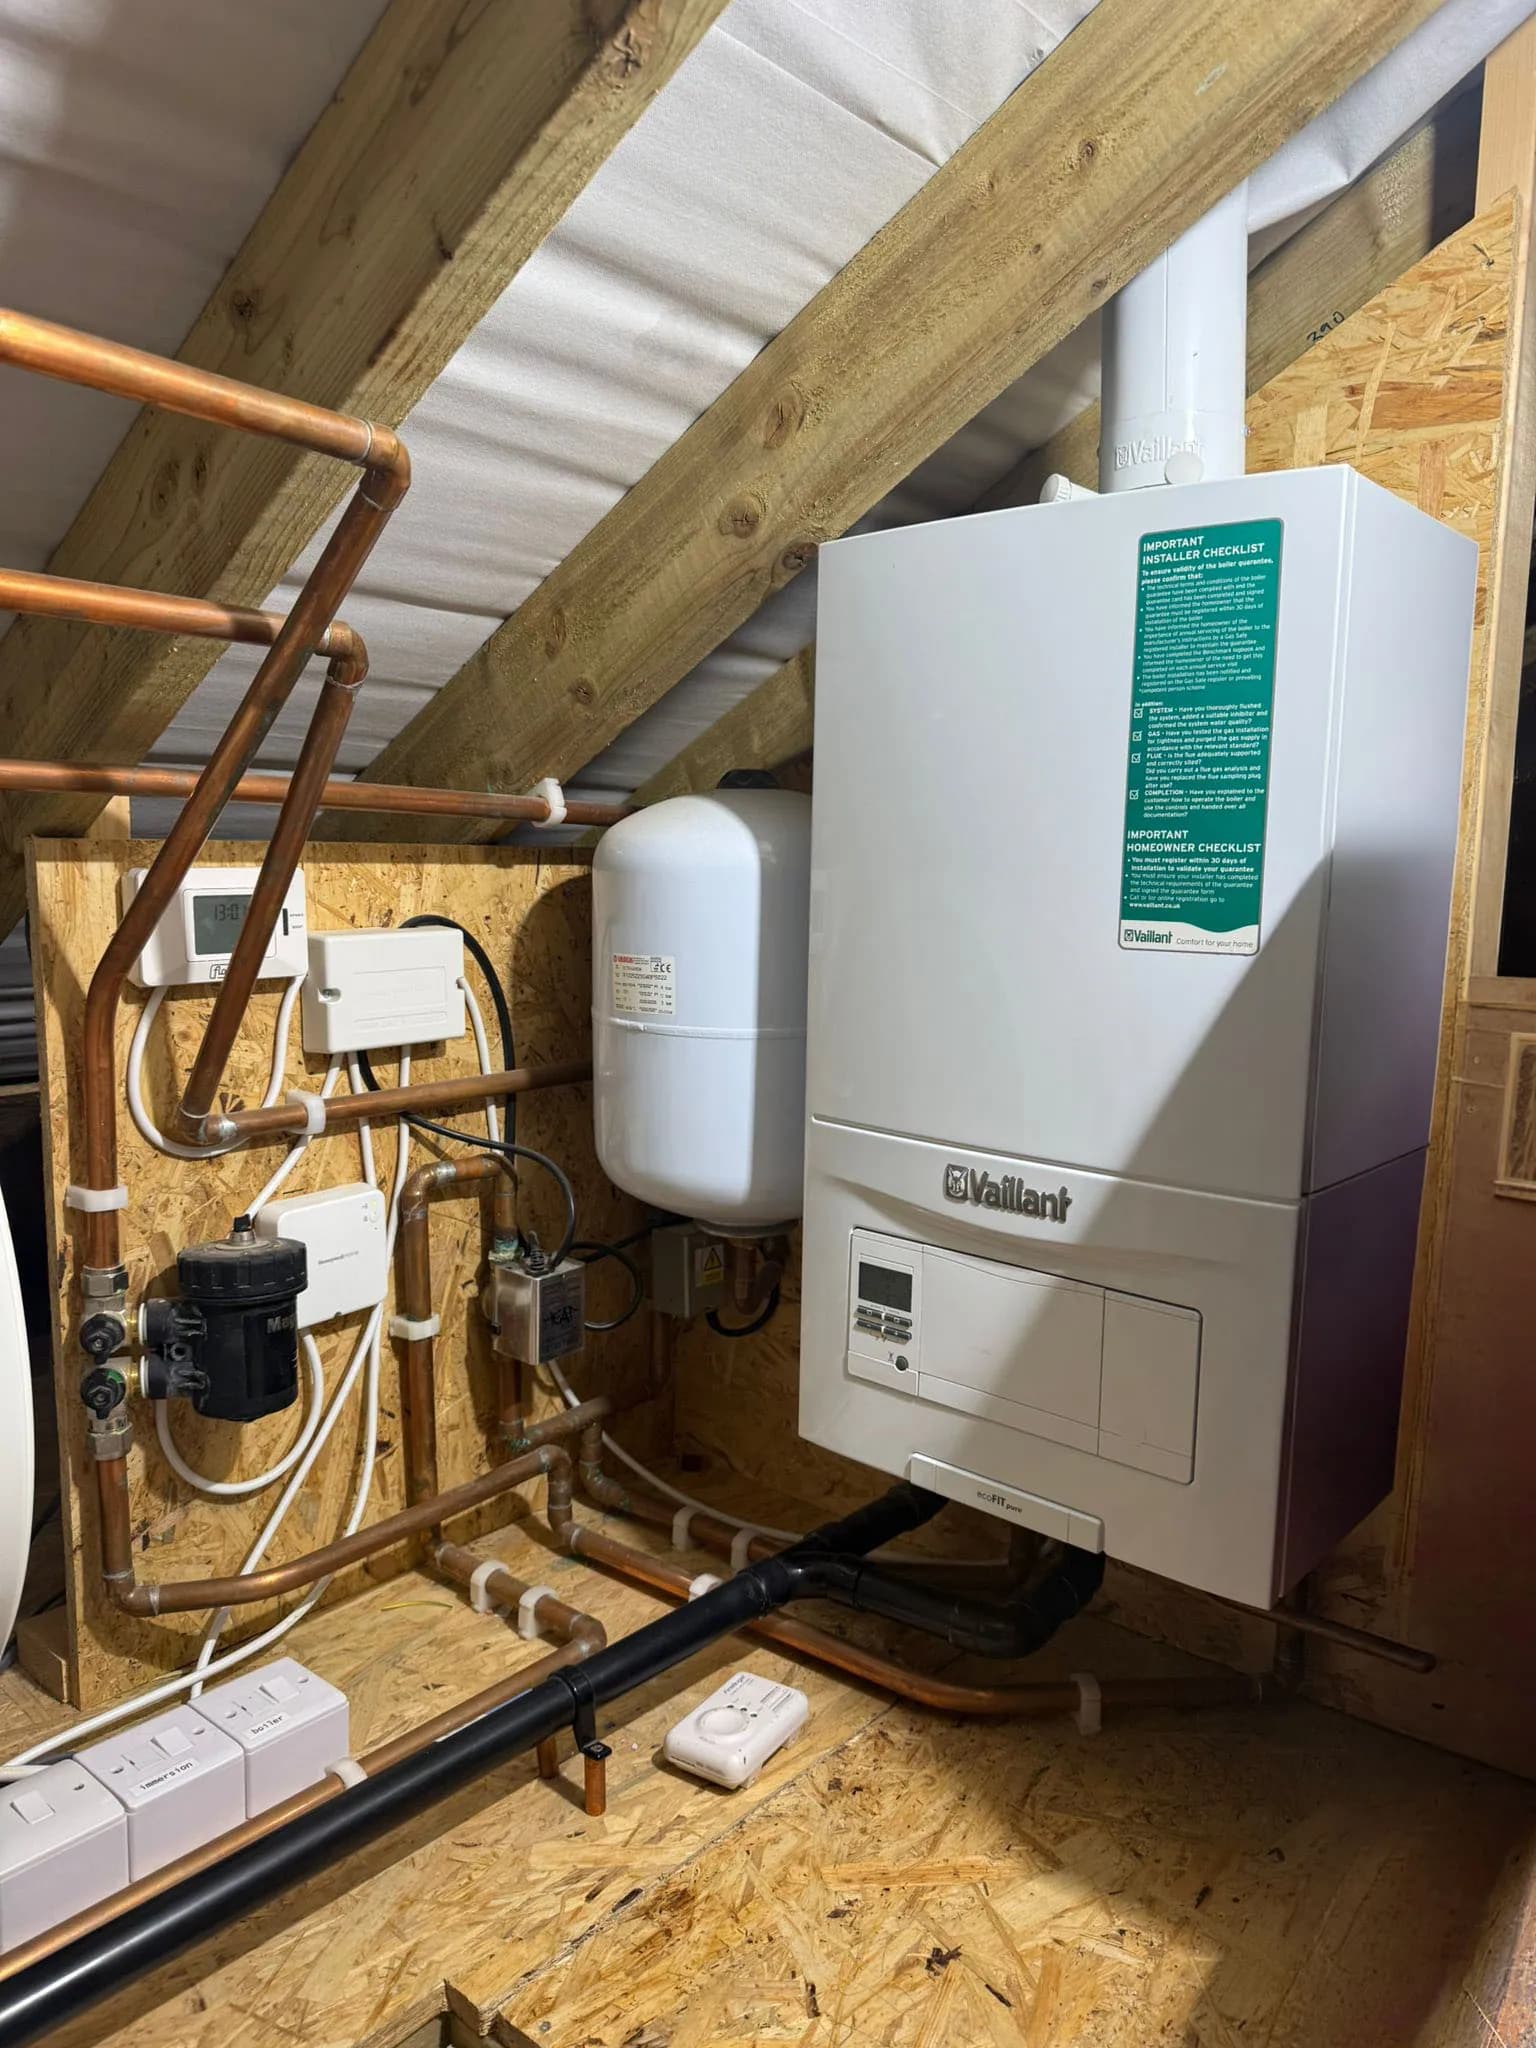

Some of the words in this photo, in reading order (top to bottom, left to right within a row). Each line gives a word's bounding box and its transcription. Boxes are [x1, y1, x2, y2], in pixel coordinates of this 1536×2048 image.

[1142, 535, 1204, 552] IMPORTANT
[1142, 548, 1200, 565] INSTALLER
[1202, 542, 1264, 558] CHECKLIST
[1172, 564, 1195, 574] validity
[1196, 563, 1204, 571] of
[1205, 562, 1216, 570] the
[1217, 560, 1236, 569] boiler
[1140, 576, 1160, 586] please
[1162, 573, 1186, 582] confirm
[1187, 572, 1203, 580] that:
[1126, 829, 1188, 839] IMPORTANT
[1126, 841, 1195, 852] HOMEOWNER
[1197, 842, 1261, 853] CHECKLIST
[1161, 856, 1187, 864] register
[1221, 857, 1237, 866] days
[1219, 866, 1254, 874] guarantee
[1134, 929, 1173, 944] Vaillant
[1176, 937, 1204, 946] Comfort
[1205, 938, 1215, 946] for
[1216, 940, 1231, 948] your
[1232, 940, 1253, 948] home
[970, 1168, 1072, 1224] Vaillant
[977, 1490, 1006, 1507] ecoFIT
[1006, 1503, 1023, 1513] pure
[251, 1714, 284, 1735] boiler
[139, 1761, 193, 1790] immersion
